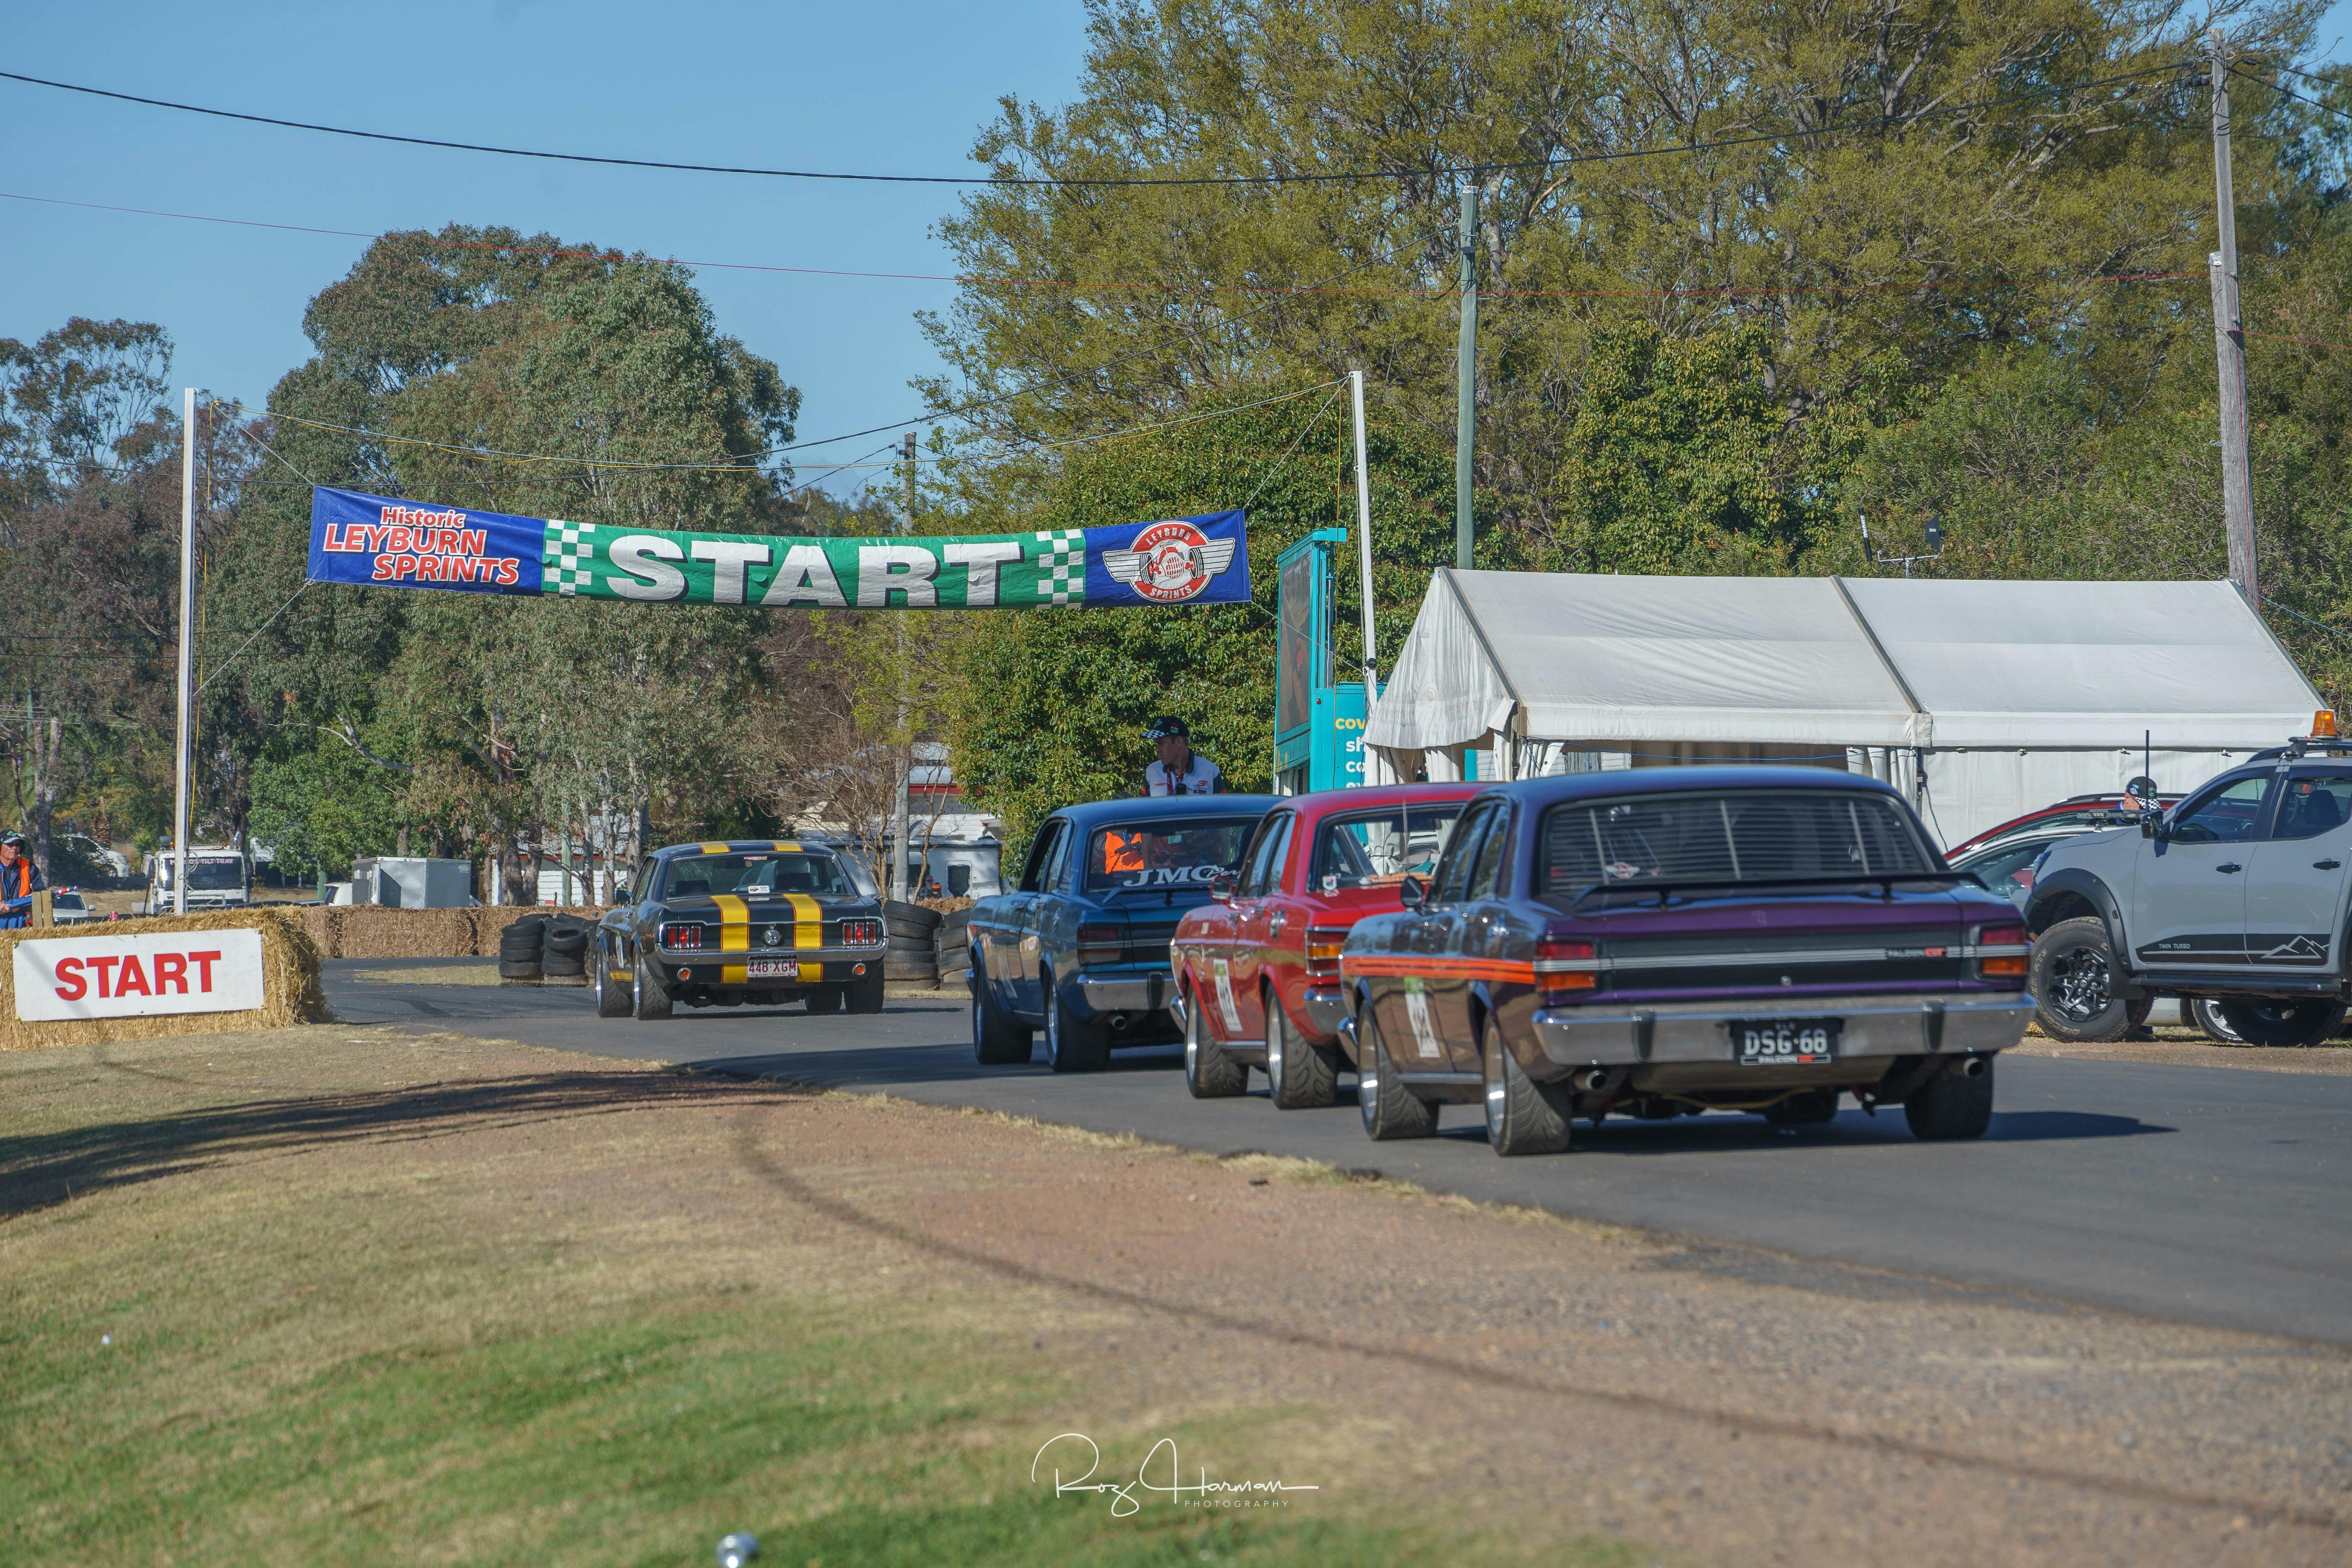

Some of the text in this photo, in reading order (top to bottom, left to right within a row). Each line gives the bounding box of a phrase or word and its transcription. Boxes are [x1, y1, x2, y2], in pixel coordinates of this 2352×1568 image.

[380, 506, 466, 528] Historic
[323, 523, 487, 557] LEYBURN
[1146, 527, 1191, 546] LEYBURN
[371, 553, 520, 584] SPRINTS
[606, 535, 1021, 607] START
[1150, 584, 1192, 599] SPRINTS
[1123, 865, 1215, 887] JMC
[55, 951, 221, 1001] START
